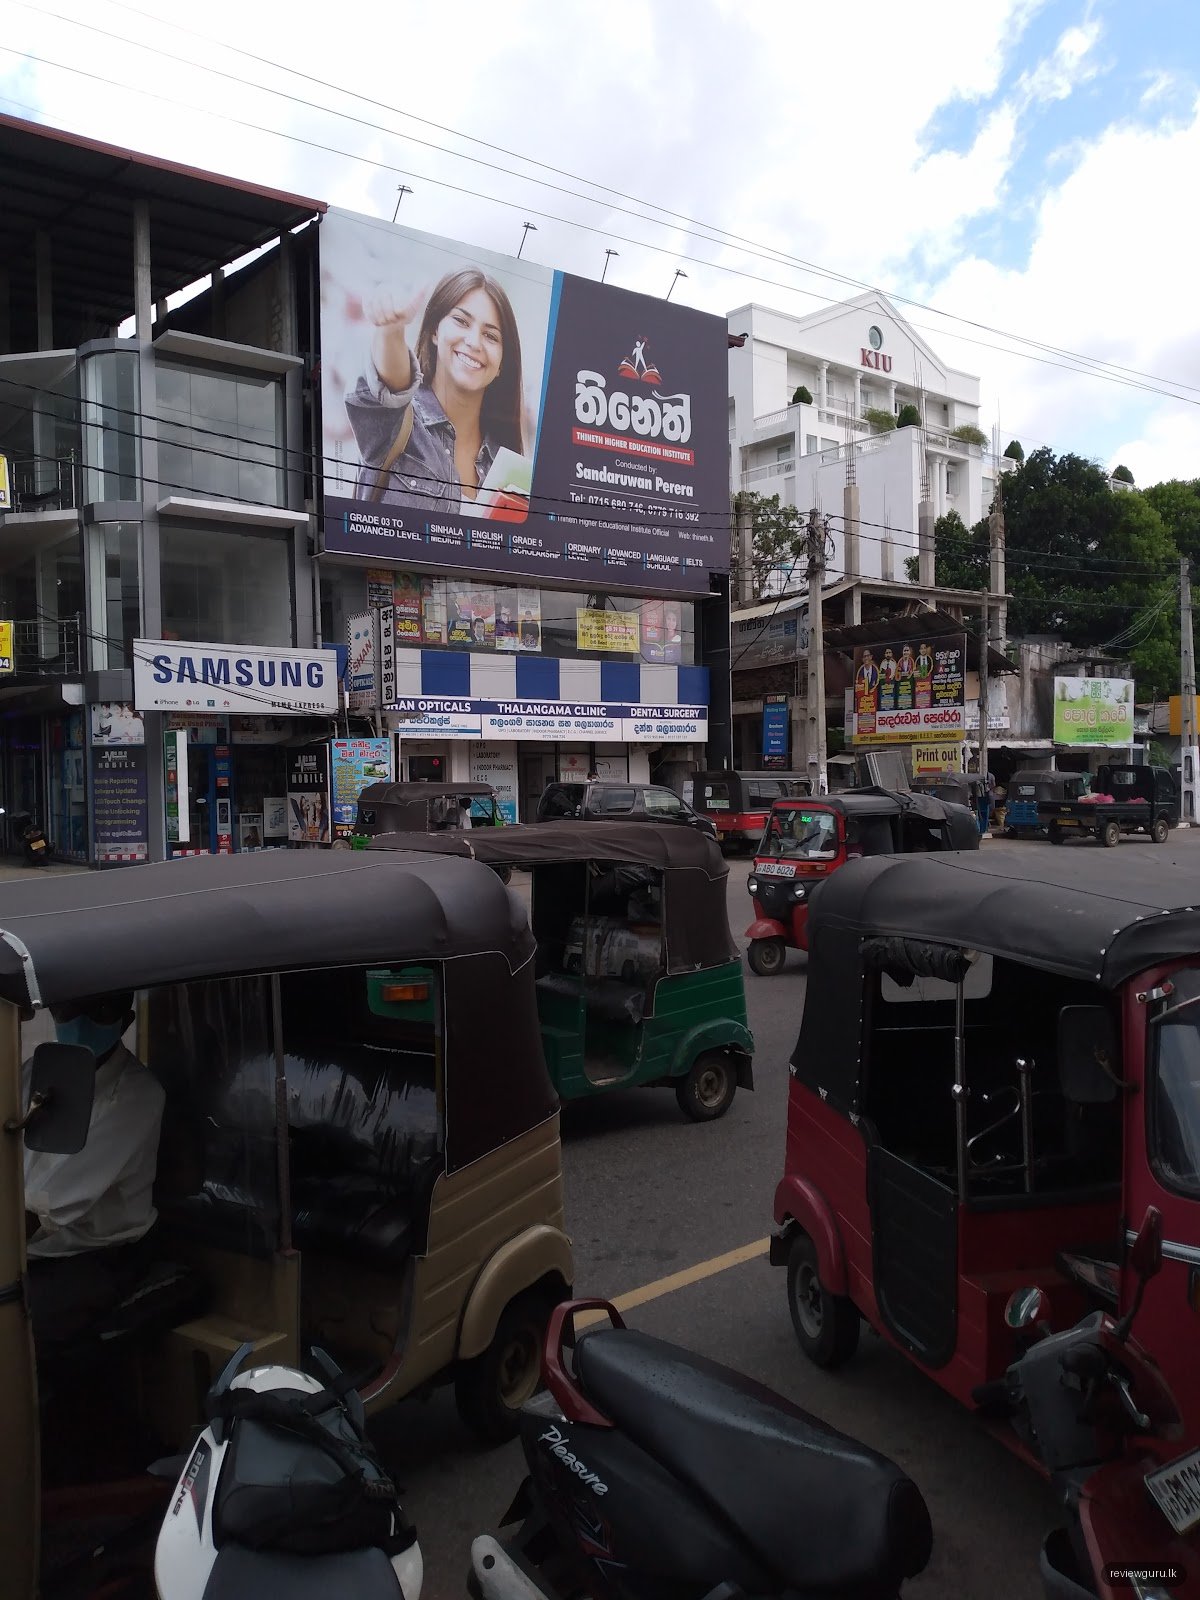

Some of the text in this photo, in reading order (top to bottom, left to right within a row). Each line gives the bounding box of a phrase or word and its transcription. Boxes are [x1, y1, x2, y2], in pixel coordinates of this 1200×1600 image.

[861, 348, 892, 373] KIU
[576, 432, 690, 461] THINETH HIGHER EDUCATION INSTITUTE
[615, 459, 648, 473] Conducted
[576, 462, 694, 497] Sandaruwan Perera
[350, 513, 403, 528] GRADE 03 TO
[598, 520, 630, 532] Educational
[630, 524, 651, 534] Institute
[350, 524, 422, 541] ADVANCED LEVEL
[430, 524, 464, 536] SINHALA
[472, 530, 503, 542] ENGLISH
[512, 535, 543, 547] GRADE 5
[568, 542, 601, 554] ORDINARY
[607, 548, 641, 560] ADVANCED
[646, 553, 679, 564] LANGUAGE
[686, 558, 704, 567] IELTS
[352, 640, 372, 673] SHAN
[153, 655, 324, 688] SAMSUNG
[418, 702, 471, 712] OPTICALS
[498, 704, 606, 716] THALANGAMA CLINIC
[630, 708, 700, 718] DENTAL SURGERY
[916, 748, 958, 762] Print out
[292, 773, 324, 784] MOBILE
[538, 1425, 608, 1496] Pleasure
